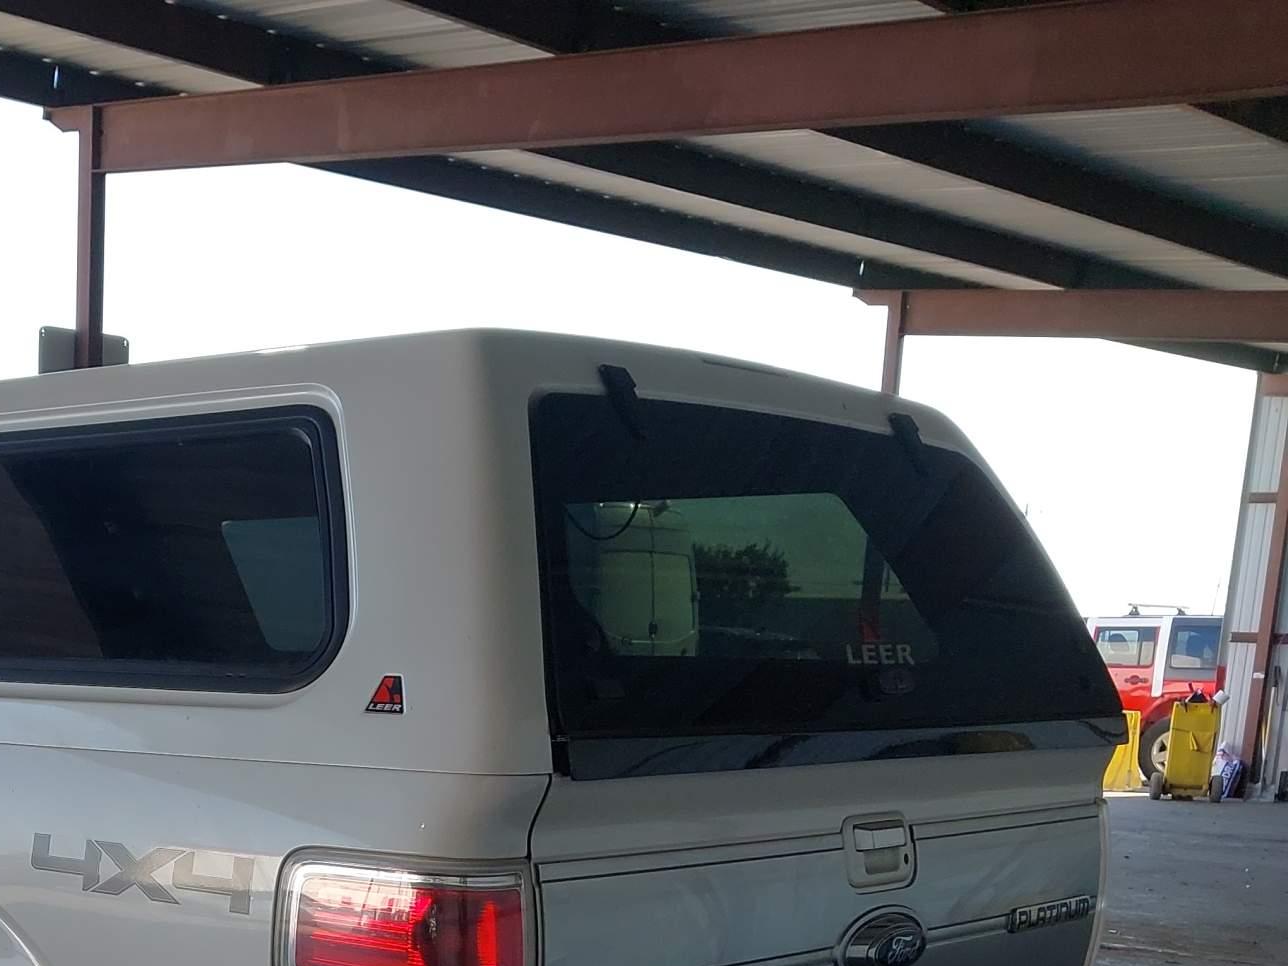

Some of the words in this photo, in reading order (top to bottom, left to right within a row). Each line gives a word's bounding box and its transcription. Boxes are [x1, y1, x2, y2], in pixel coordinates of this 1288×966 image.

[845, 643, 915, 665] LEER
[367, 703, 402, 711] LEER
[1017, 896, 1090, 929] PLATINUM
[887, 935, 920, 964] Ford
